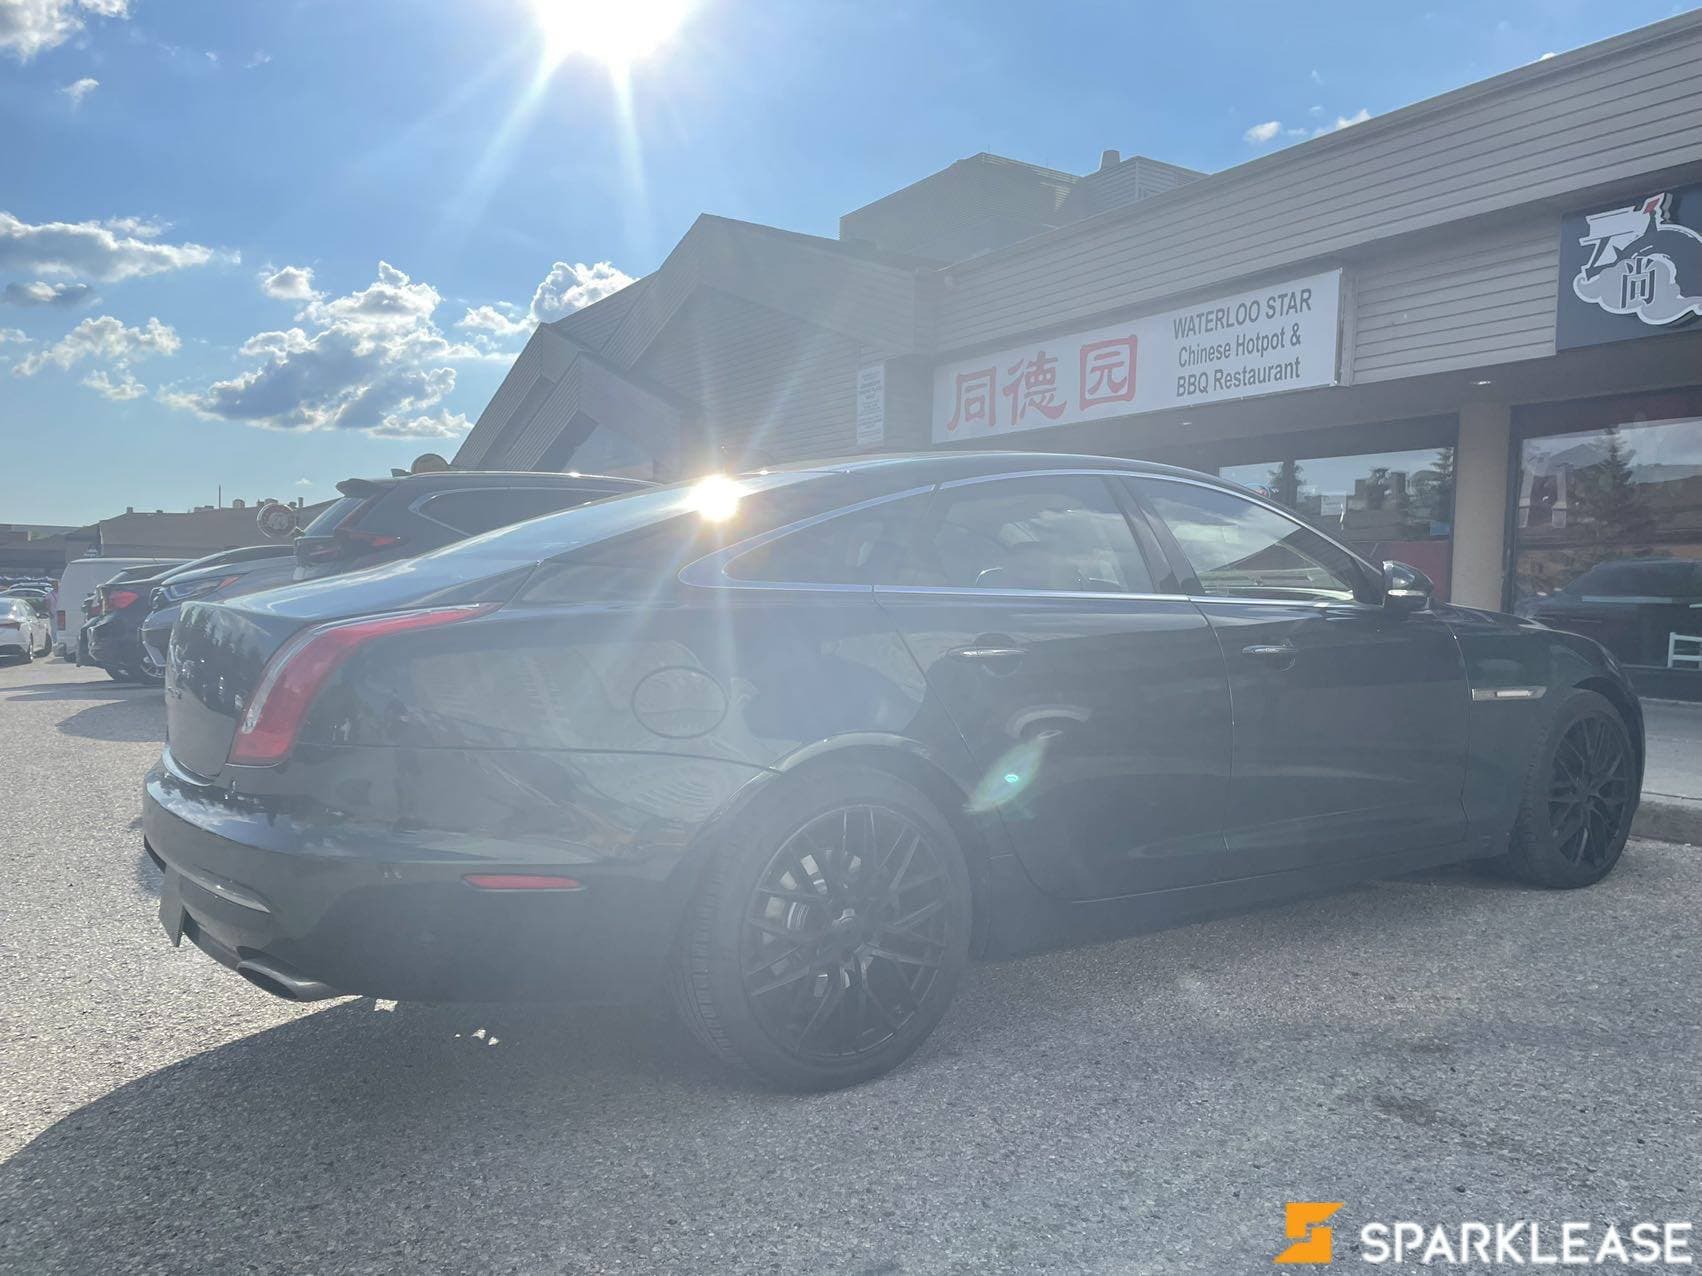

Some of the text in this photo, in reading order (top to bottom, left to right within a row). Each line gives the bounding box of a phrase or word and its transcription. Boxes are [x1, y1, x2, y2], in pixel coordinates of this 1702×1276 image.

[1173, 288, 1312, 340] WATERLOO STAR
[1179, 322, 1301, 368] Chinese Hotpot &
[947, 335, 1138, 432] 同德园
[1176, 356, 1301, 397] BBQ Restaurant
